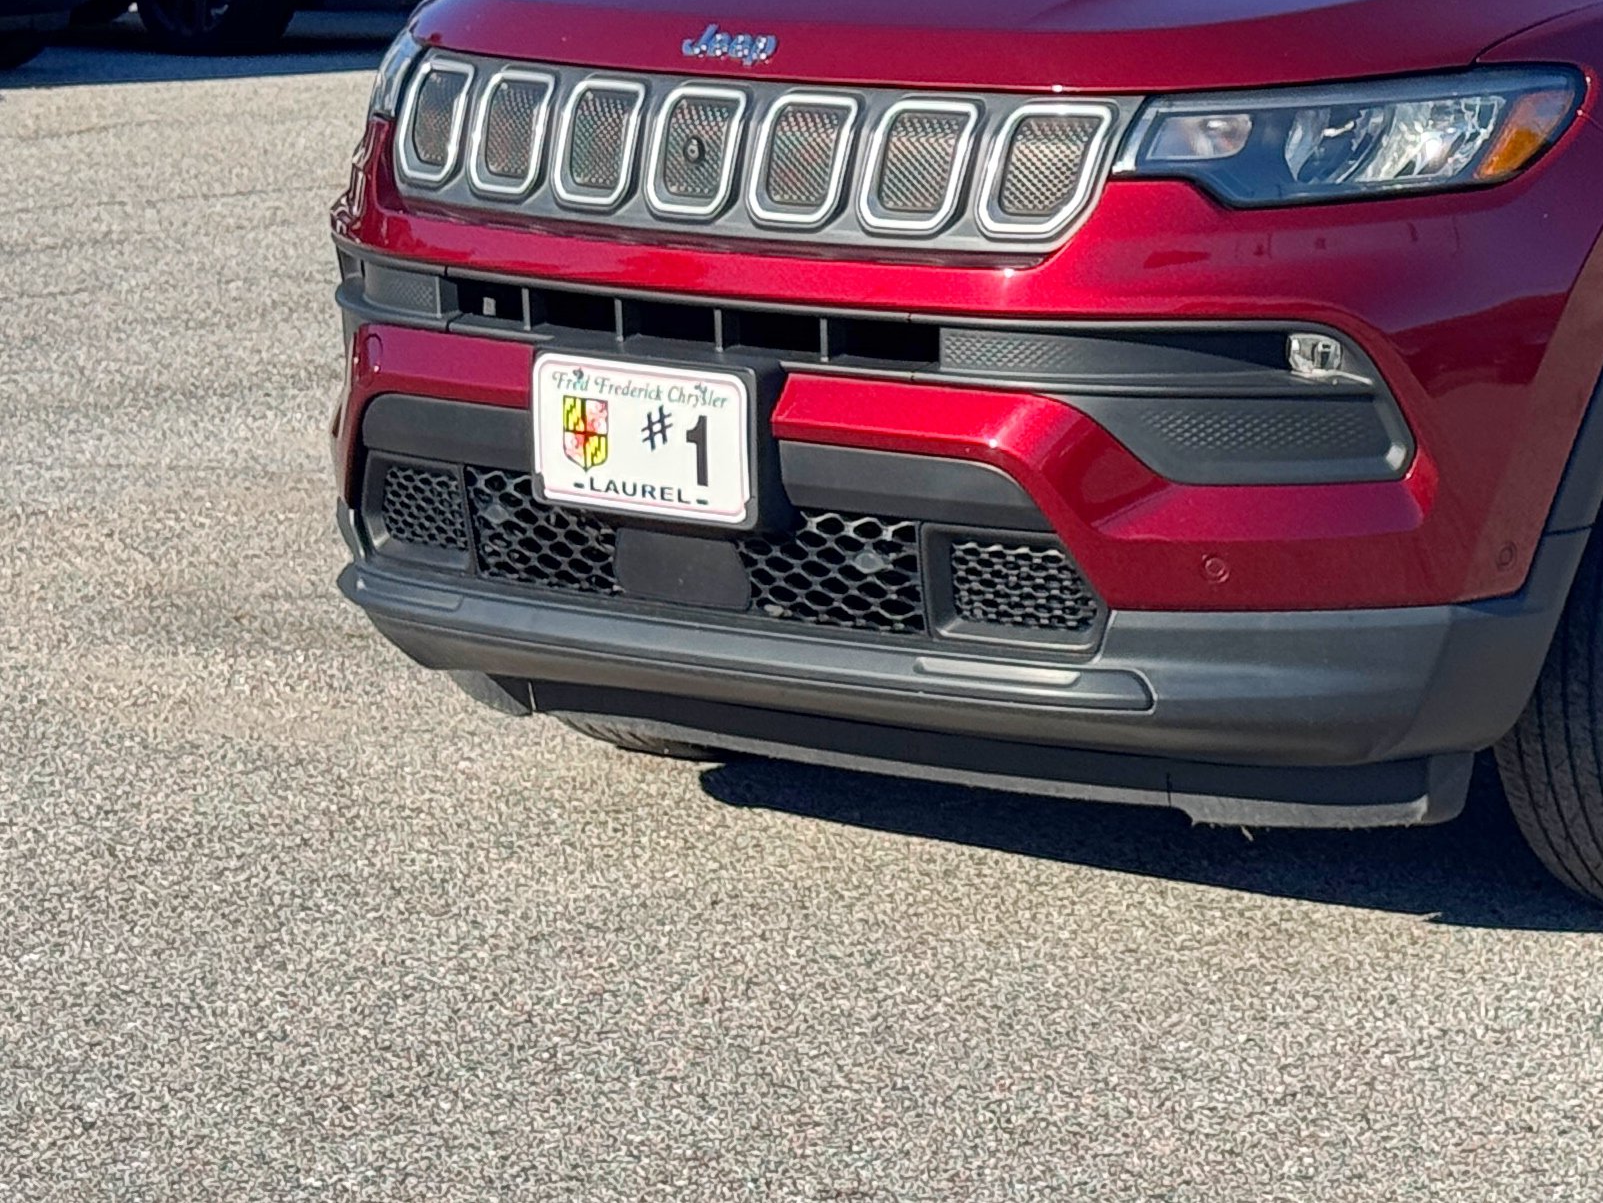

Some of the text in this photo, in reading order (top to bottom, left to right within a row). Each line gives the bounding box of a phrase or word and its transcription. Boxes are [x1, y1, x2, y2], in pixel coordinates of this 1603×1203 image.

[682, 24, 777, 67] Jeep
[552, 371, 728, 409] Fred Frederick Chrysler
